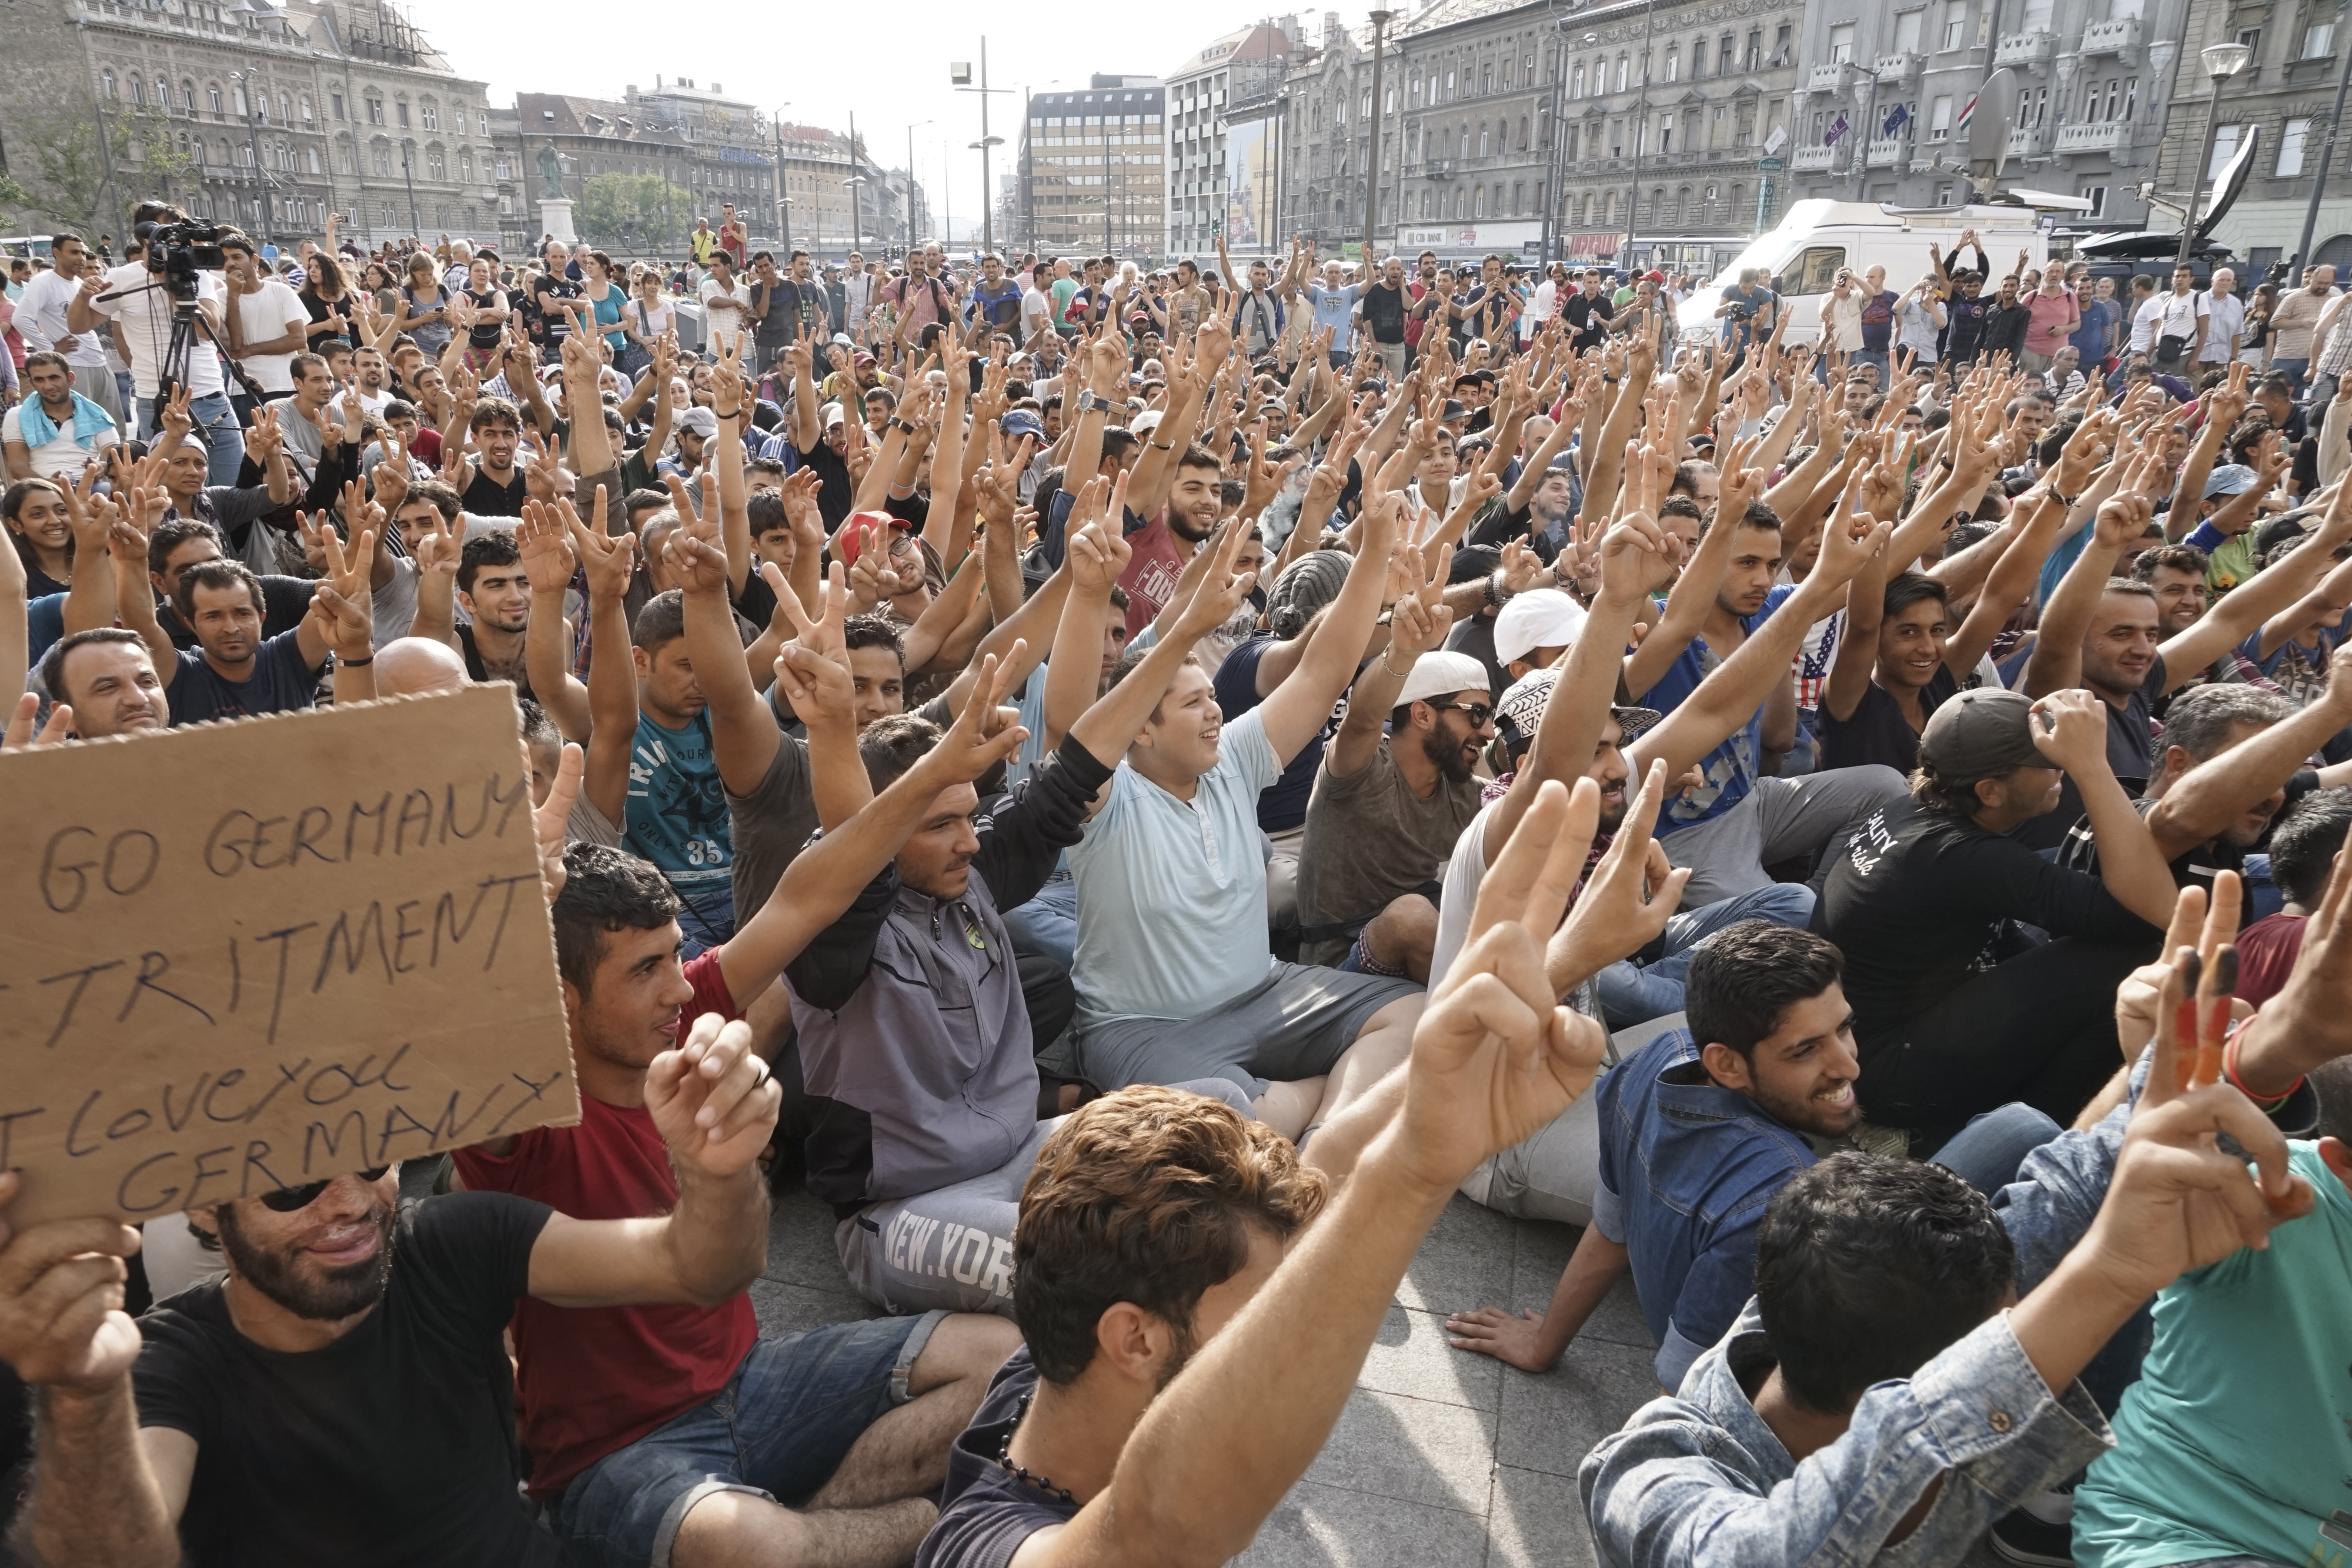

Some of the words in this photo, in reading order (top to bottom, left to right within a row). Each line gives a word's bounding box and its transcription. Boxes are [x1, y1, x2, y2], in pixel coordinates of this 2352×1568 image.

[1757, 176, 1767, 226] HOTEL
[1763, 176, 1774, 226] HOTEL
[1427, 233, 1442, 242] BANK
[41, 826, 159, 913] GO
[204, 772, 527, 877] GERMANY
[638, 821, 672, 851] ONLY
[118, 1071, 563, 1211] GERMANY
[885, 1209, 1014, 1299] NEW.YOR
